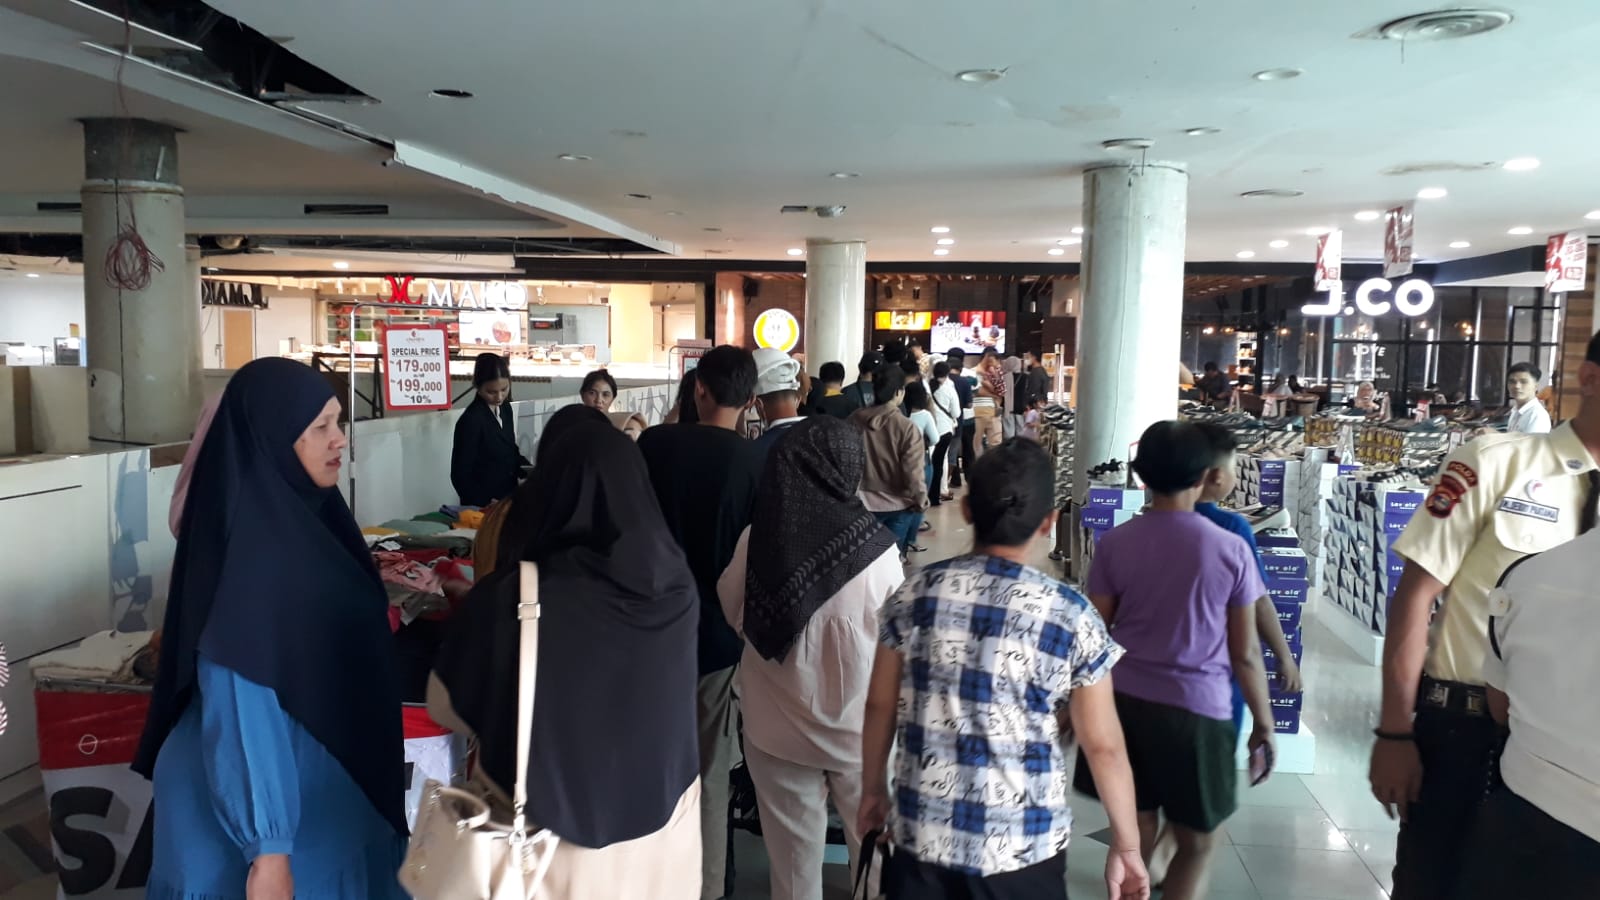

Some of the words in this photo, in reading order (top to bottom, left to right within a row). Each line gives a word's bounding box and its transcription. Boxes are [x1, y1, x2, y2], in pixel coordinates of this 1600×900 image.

[1300, 277, 1435, 316] J.CO
[391, 347, 419, 356] SPECIAL
[421, 347, 440, 356] PRICE
[396, 359, 441, 372] 179.000
[397, 379, 442, 392] 199.000
[411, 395, 432, 404] 10%
